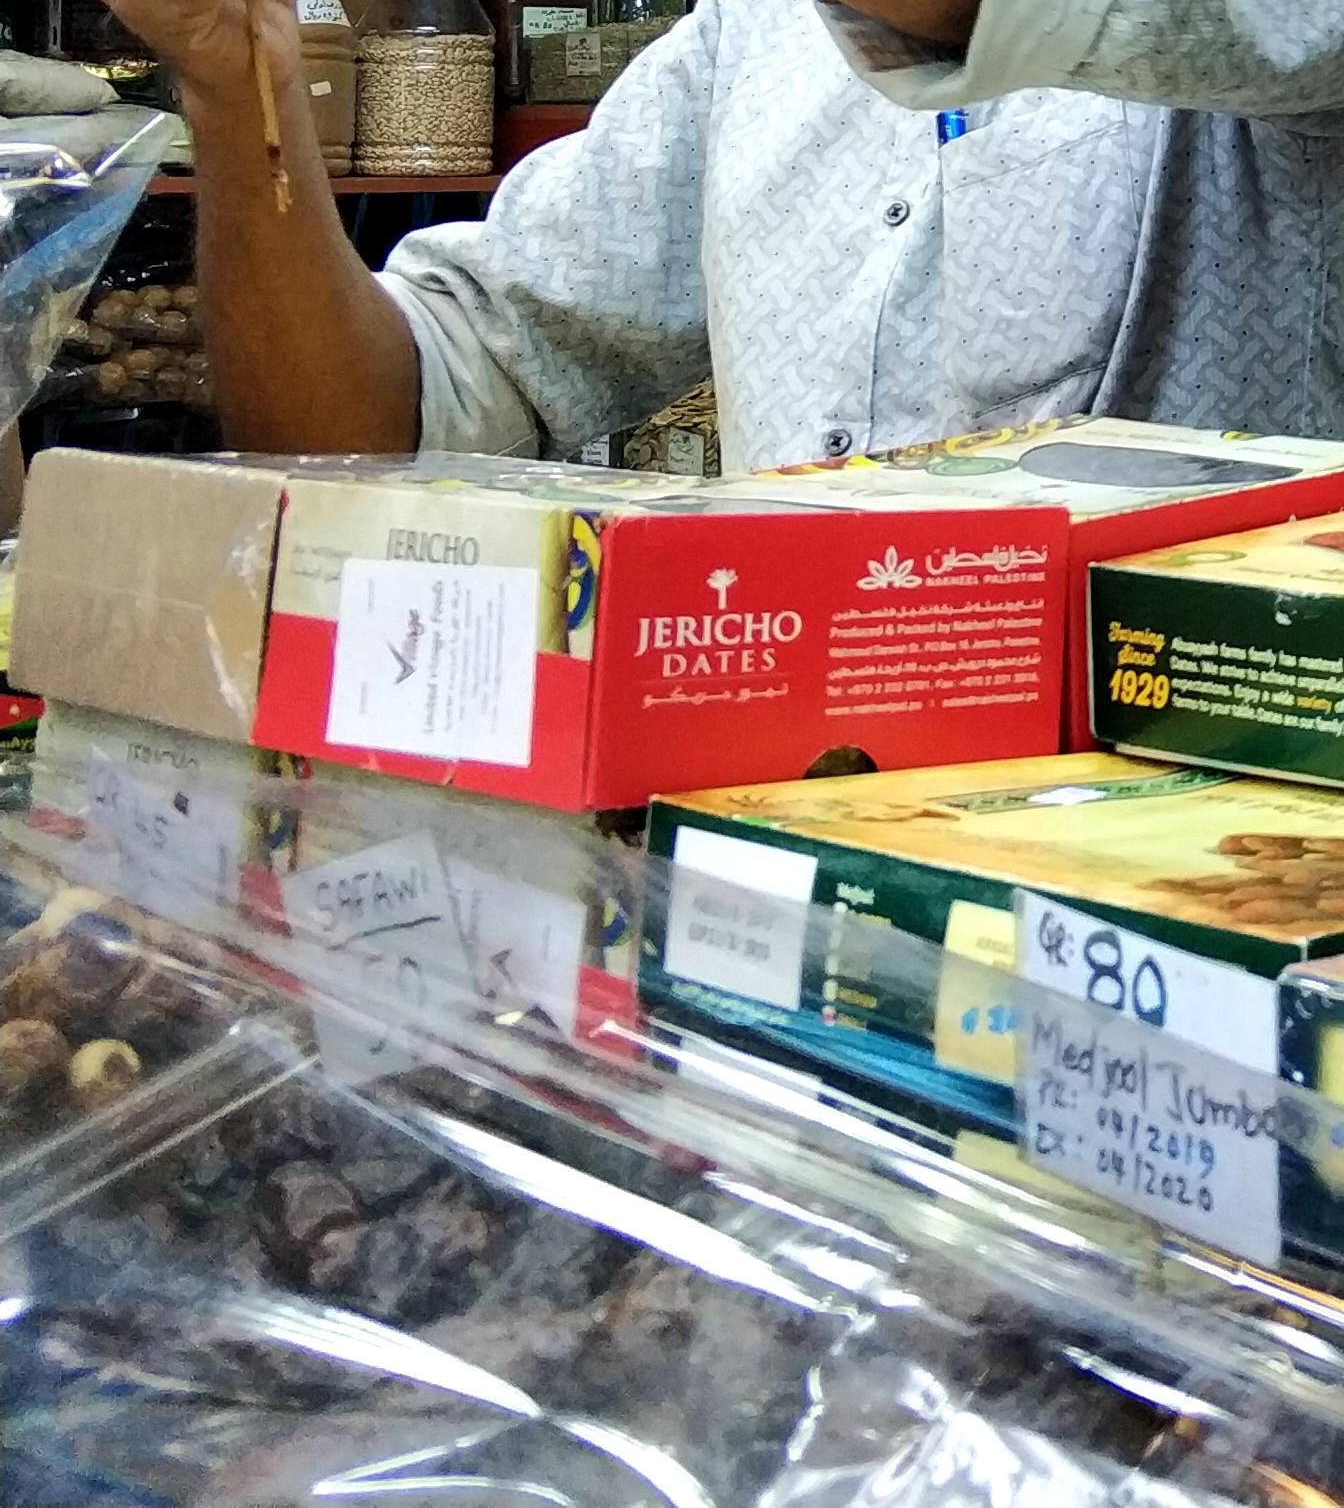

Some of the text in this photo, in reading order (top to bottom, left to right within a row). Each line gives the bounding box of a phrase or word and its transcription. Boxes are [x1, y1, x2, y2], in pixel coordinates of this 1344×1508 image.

[633, 609, 804, 658] JERICHO
[661, 647, 777, 678] DATES
[1108, 668, 1172, 711] 1929
[1083, 928, 1168, 1028] 80
